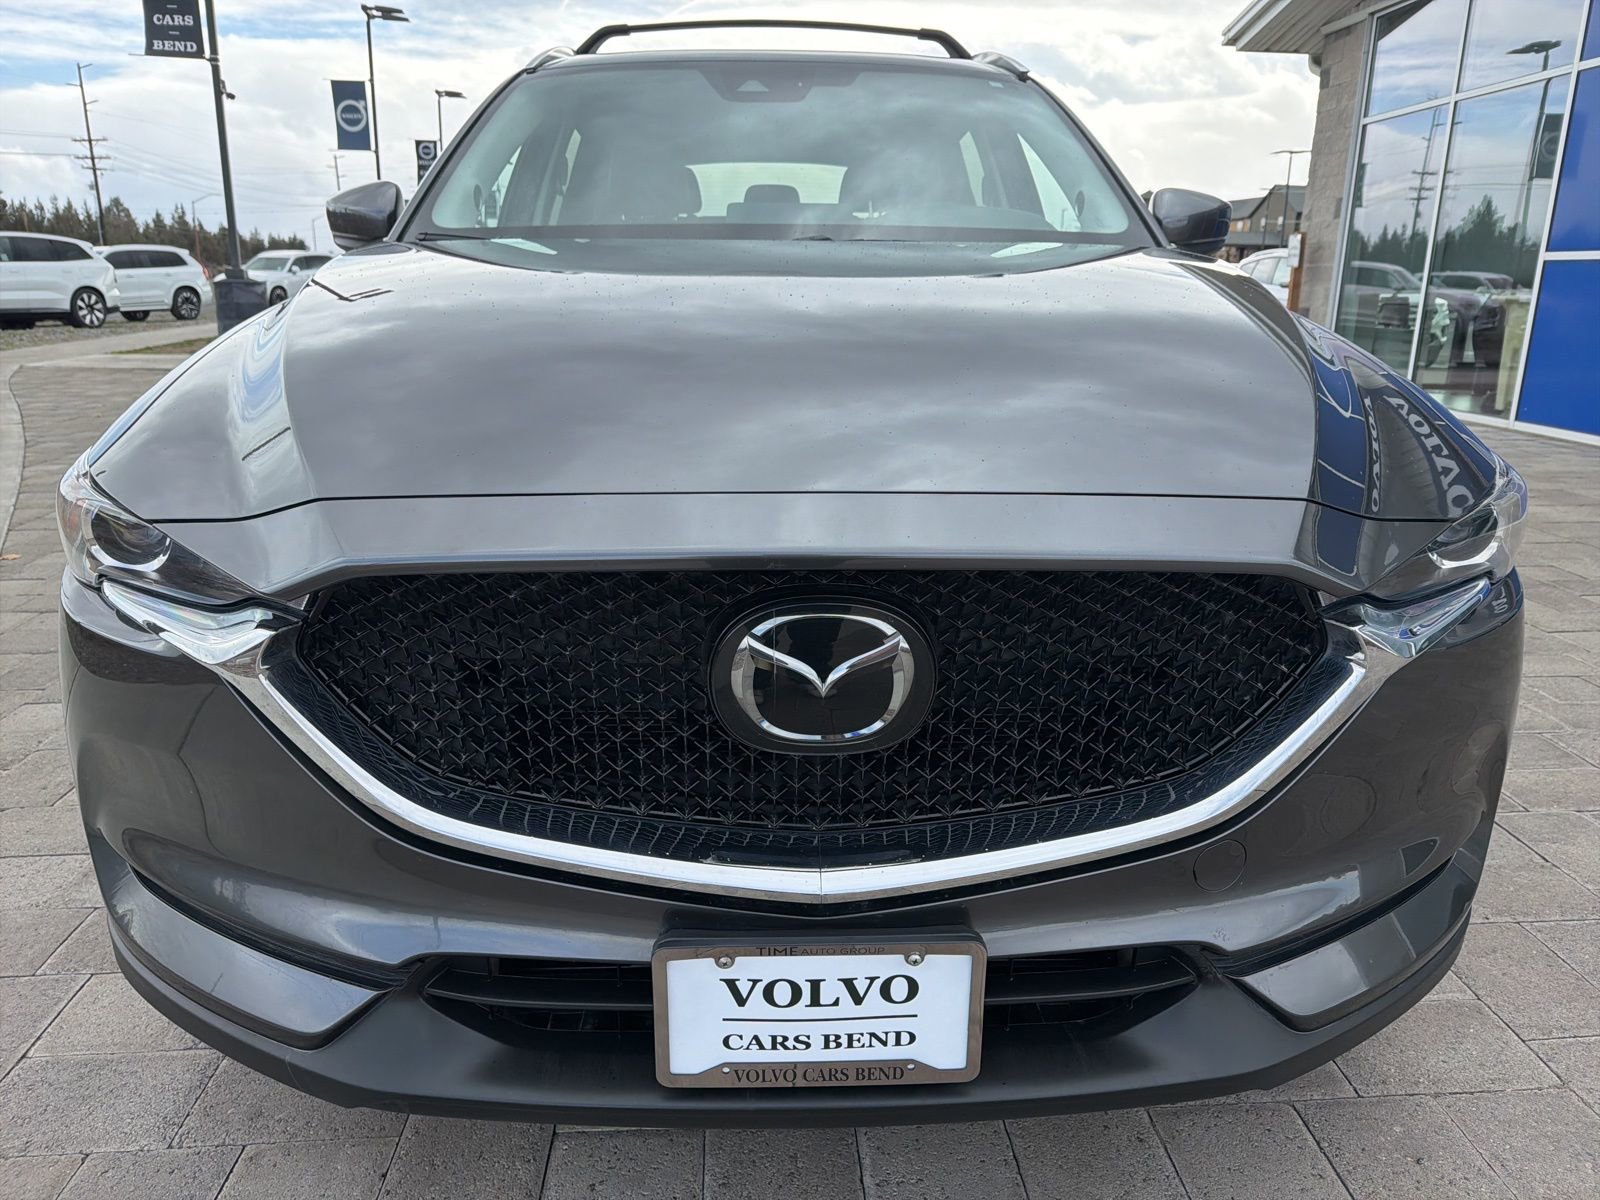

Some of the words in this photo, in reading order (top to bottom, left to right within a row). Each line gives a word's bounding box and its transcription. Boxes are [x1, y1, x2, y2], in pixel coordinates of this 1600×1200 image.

[153, 14, 194, 26] CARS
[152, 39, 197, 52] BEND
[756, 946, 798, 956] TIME
[801, 946, 836, 955] AUTO
[840, 946, 885, 955] GROUP
[719, 974, 920, 1008] VOLVO
[722, 1033, 812, 1051] CARS
[820, 1031, 917, 1050] BEND
[734, 1069, 797, 1083] VOLVO
[803, 1068, 849, 1082] CARS
[855, 1066, 905, 1081] BEND
